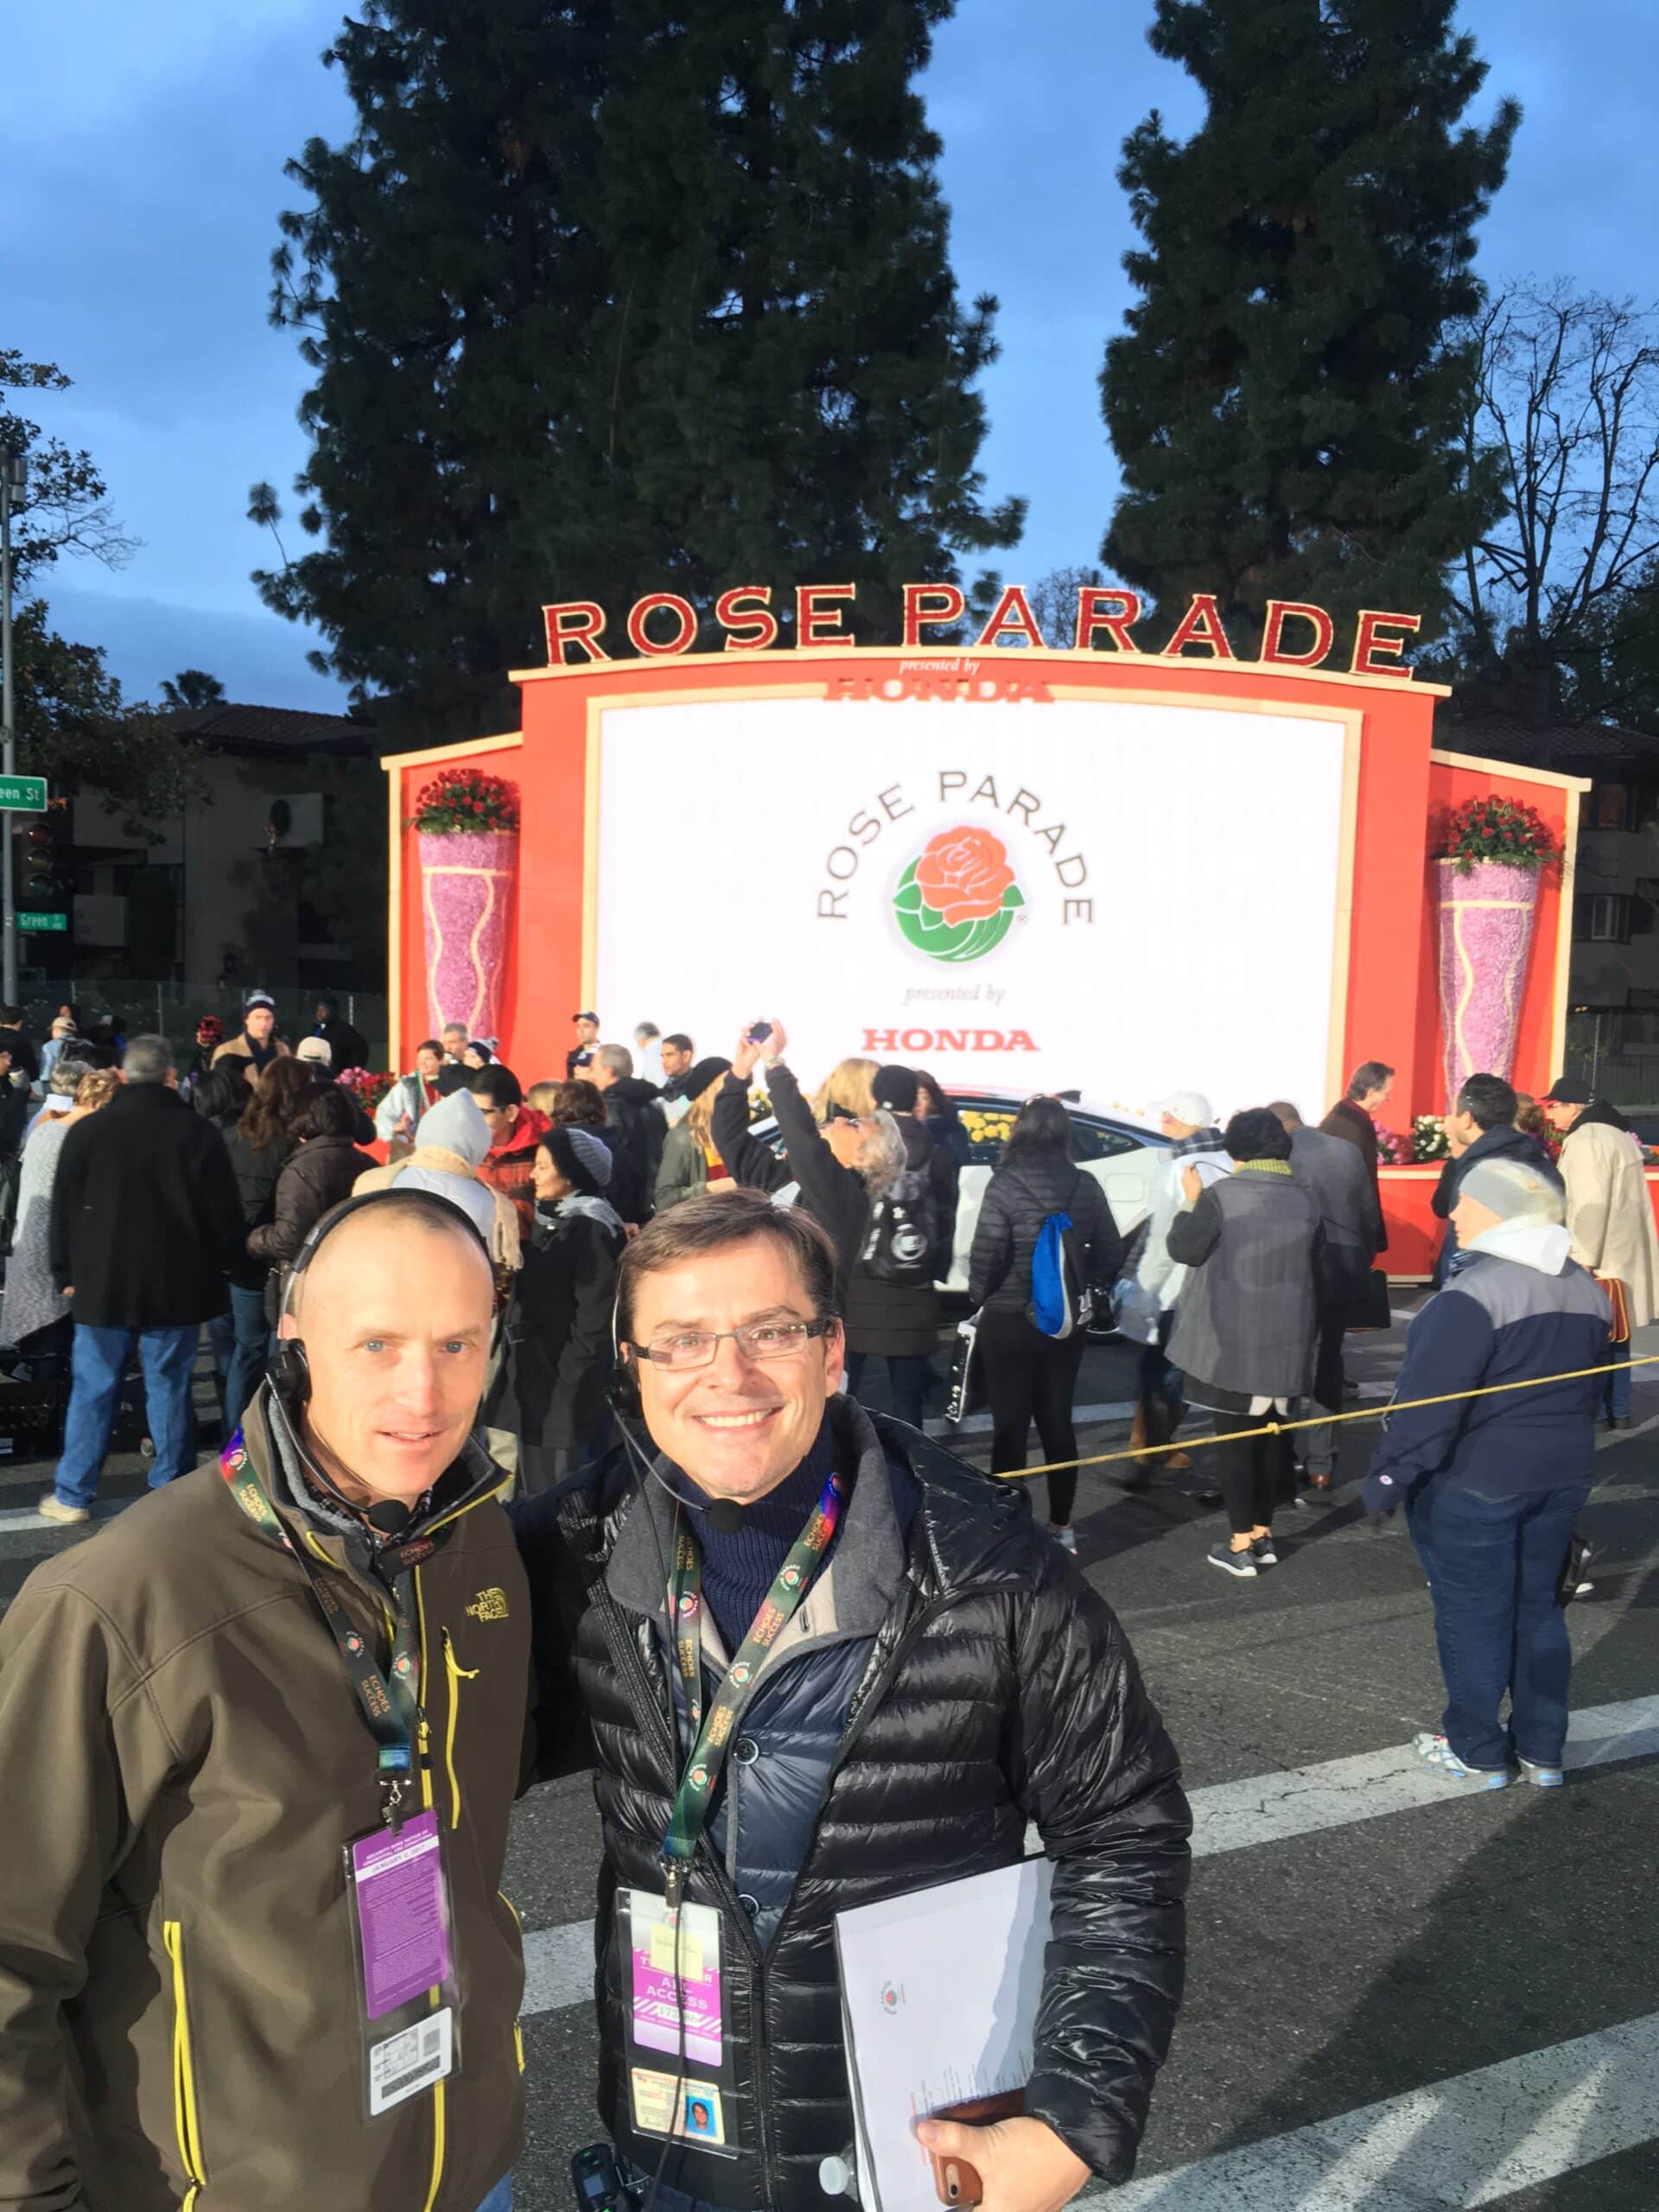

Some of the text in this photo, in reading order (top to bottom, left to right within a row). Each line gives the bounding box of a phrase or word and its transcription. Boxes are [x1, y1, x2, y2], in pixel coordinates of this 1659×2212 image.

[541, 582, 1421, 681] ROSE PARADE
[899, 658, 981, 675] presented by
[821, 679, 1055, 702] HONDA
[26, 787, 40, 801] St
[817, 771, 1094, 925] ROSE PARADE
[903, 982, 1006, 1005] presented by
[861, 1028, 1040, 1052] HONDA
[465, 1599, 500, 1617] NORTH
[475, 1588, 497, 1601] THE
[479, 1607, 503, 1623] FACE
[753, 1608, 776, 1643] ECHOES
[762, 1611, 785, 1646] SUCCESS
[361, 1679, 382, 1717] SUCCESS
[369, 1675, 391, 1713] ECHOES
[707, 1705, 727, 1742] ECHOES
[714, 1708, 734, 1747] SUCCESS
